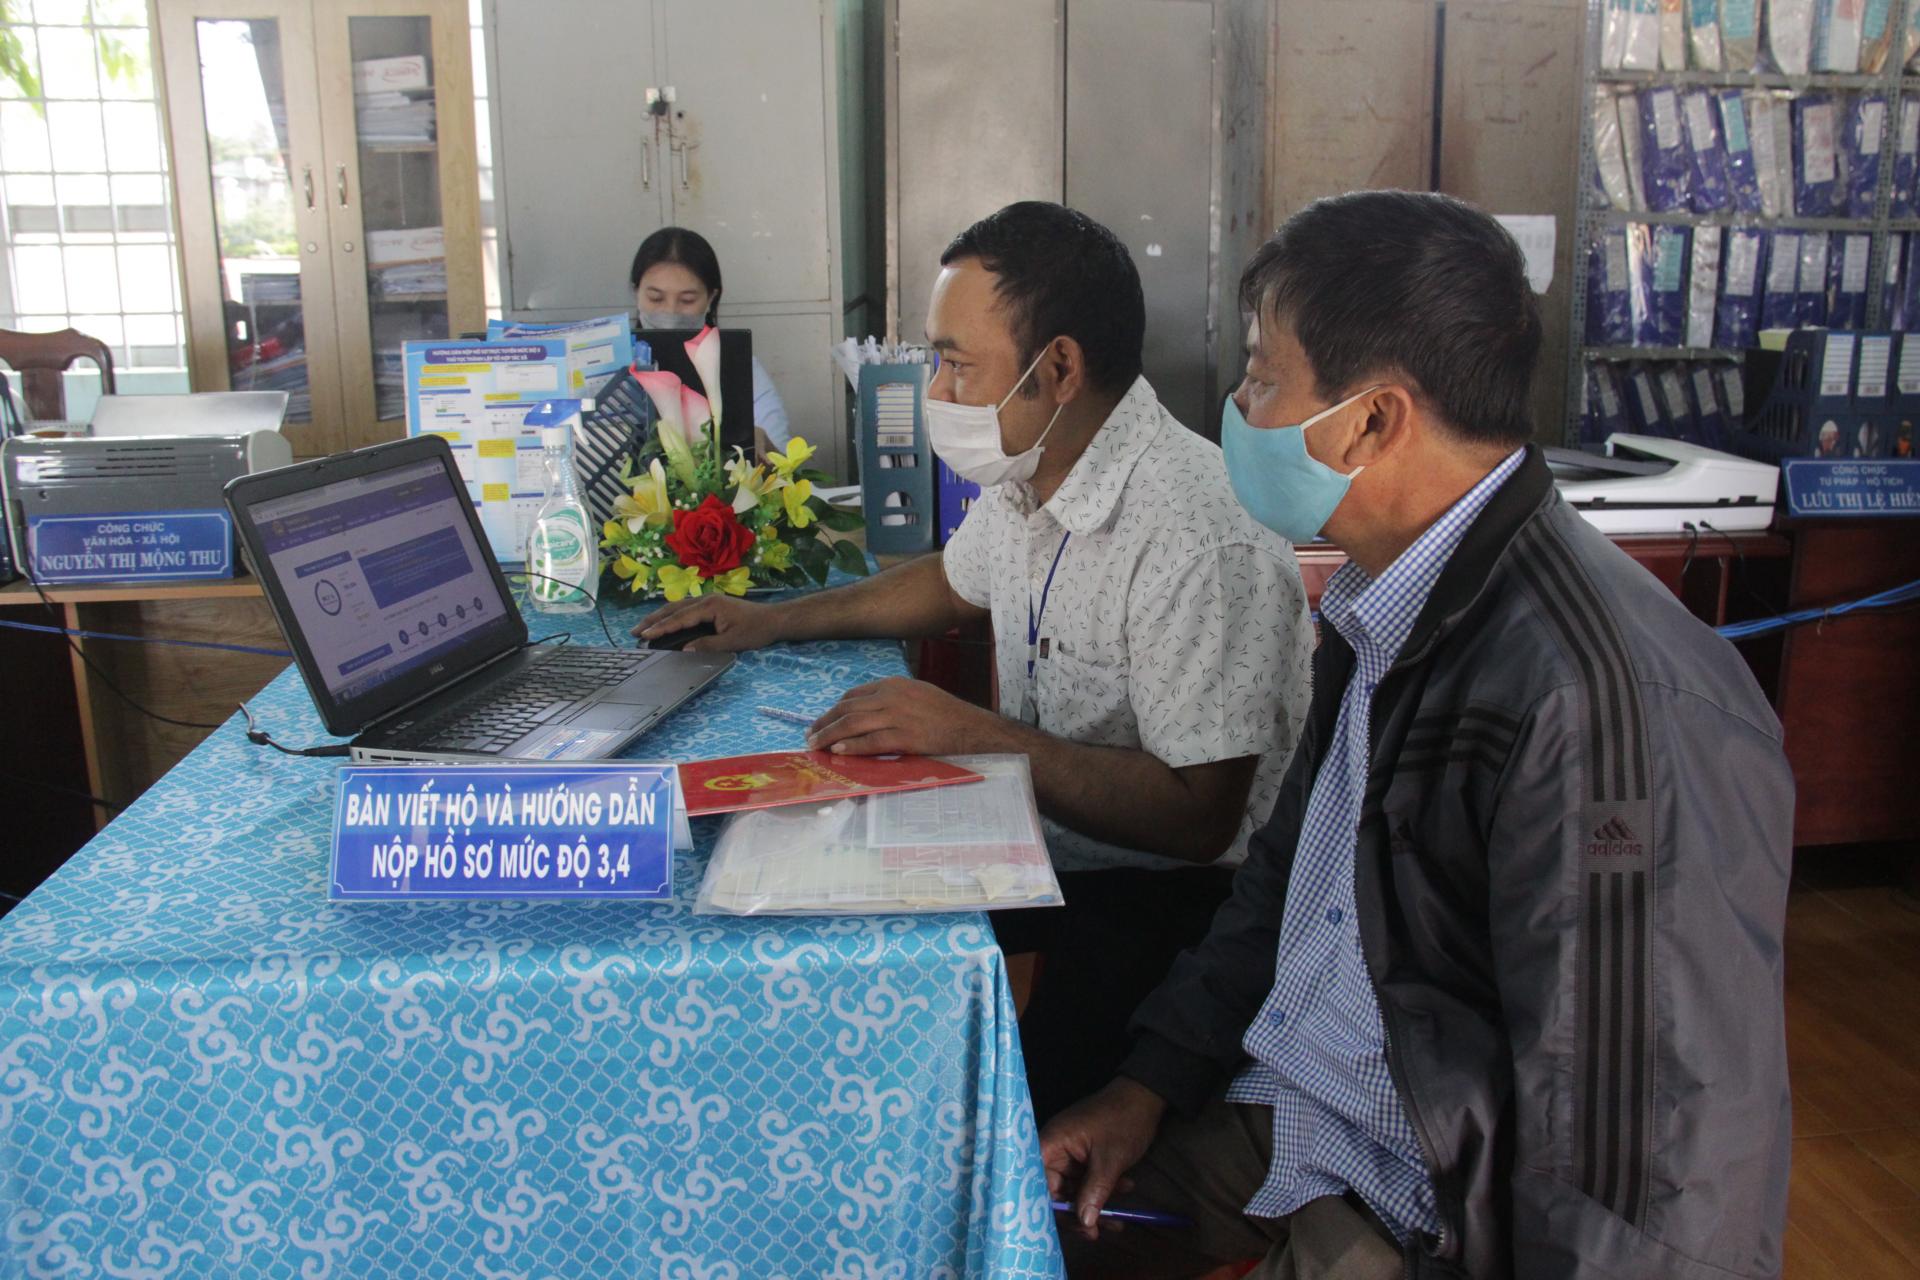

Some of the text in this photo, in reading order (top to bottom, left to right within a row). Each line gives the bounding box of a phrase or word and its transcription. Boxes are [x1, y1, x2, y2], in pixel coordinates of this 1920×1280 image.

[97, 521, 165, 534] CÔNG CHỨC
[109, 535, 134, 547] HÓA
[160, 533, 181, 546] HỘI
[41, 547, 106, 571] NGUYỄN
[109, 552, 136, 572] THỊ
[189, 550, 222, 566] THU
[346, 777, 656, 836] BÀN VIẾT HỘ VÀ HƯỚNG DẪN
[372, 827, 630, 888] NỘP HỒ SƠ MỨC ĐỘ 3,4
[1586, 839, 1643, 857] adidas
